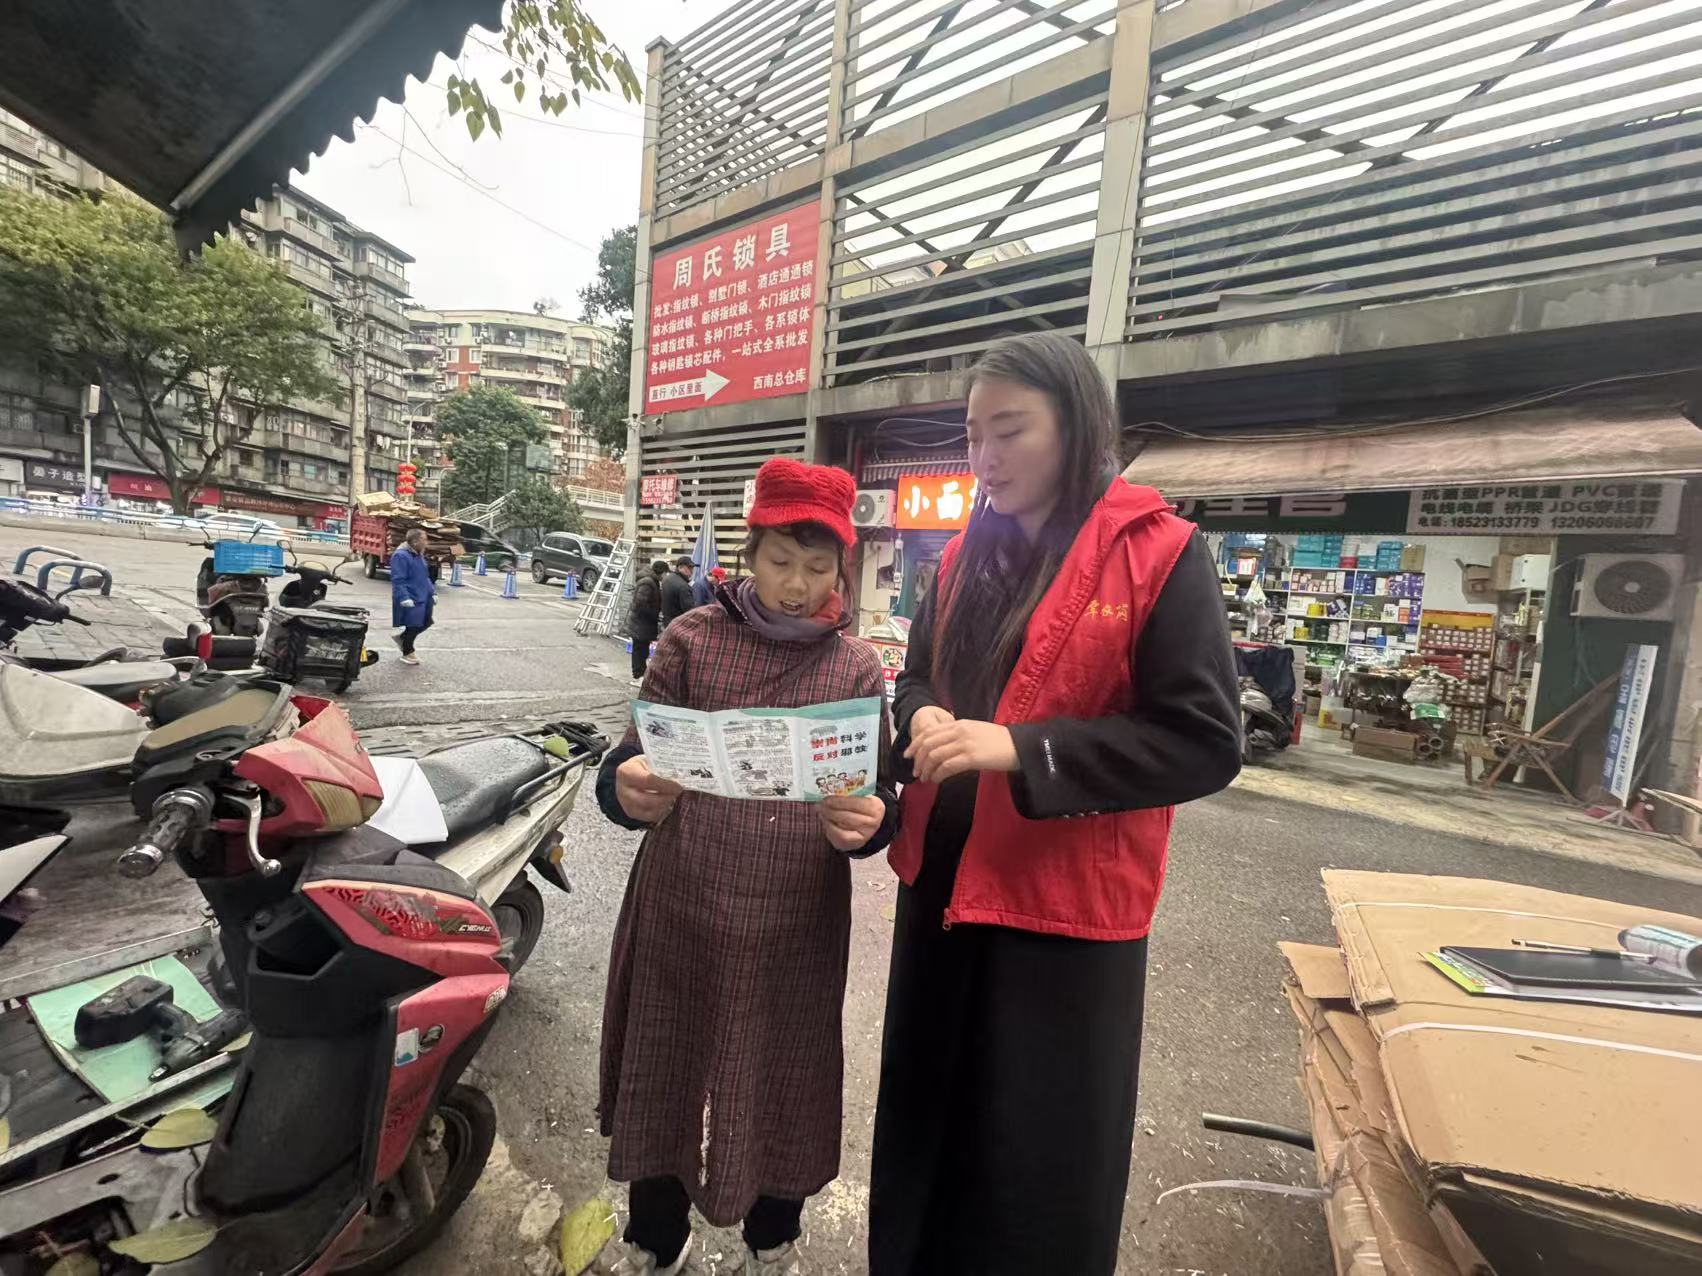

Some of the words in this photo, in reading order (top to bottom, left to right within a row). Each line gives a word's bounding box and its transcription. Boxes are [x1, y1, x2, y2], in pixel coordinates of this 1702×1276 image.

[673, 222, 791, 290] 周氏锁具
[753, 368, 806, 390] 西南总仓库
